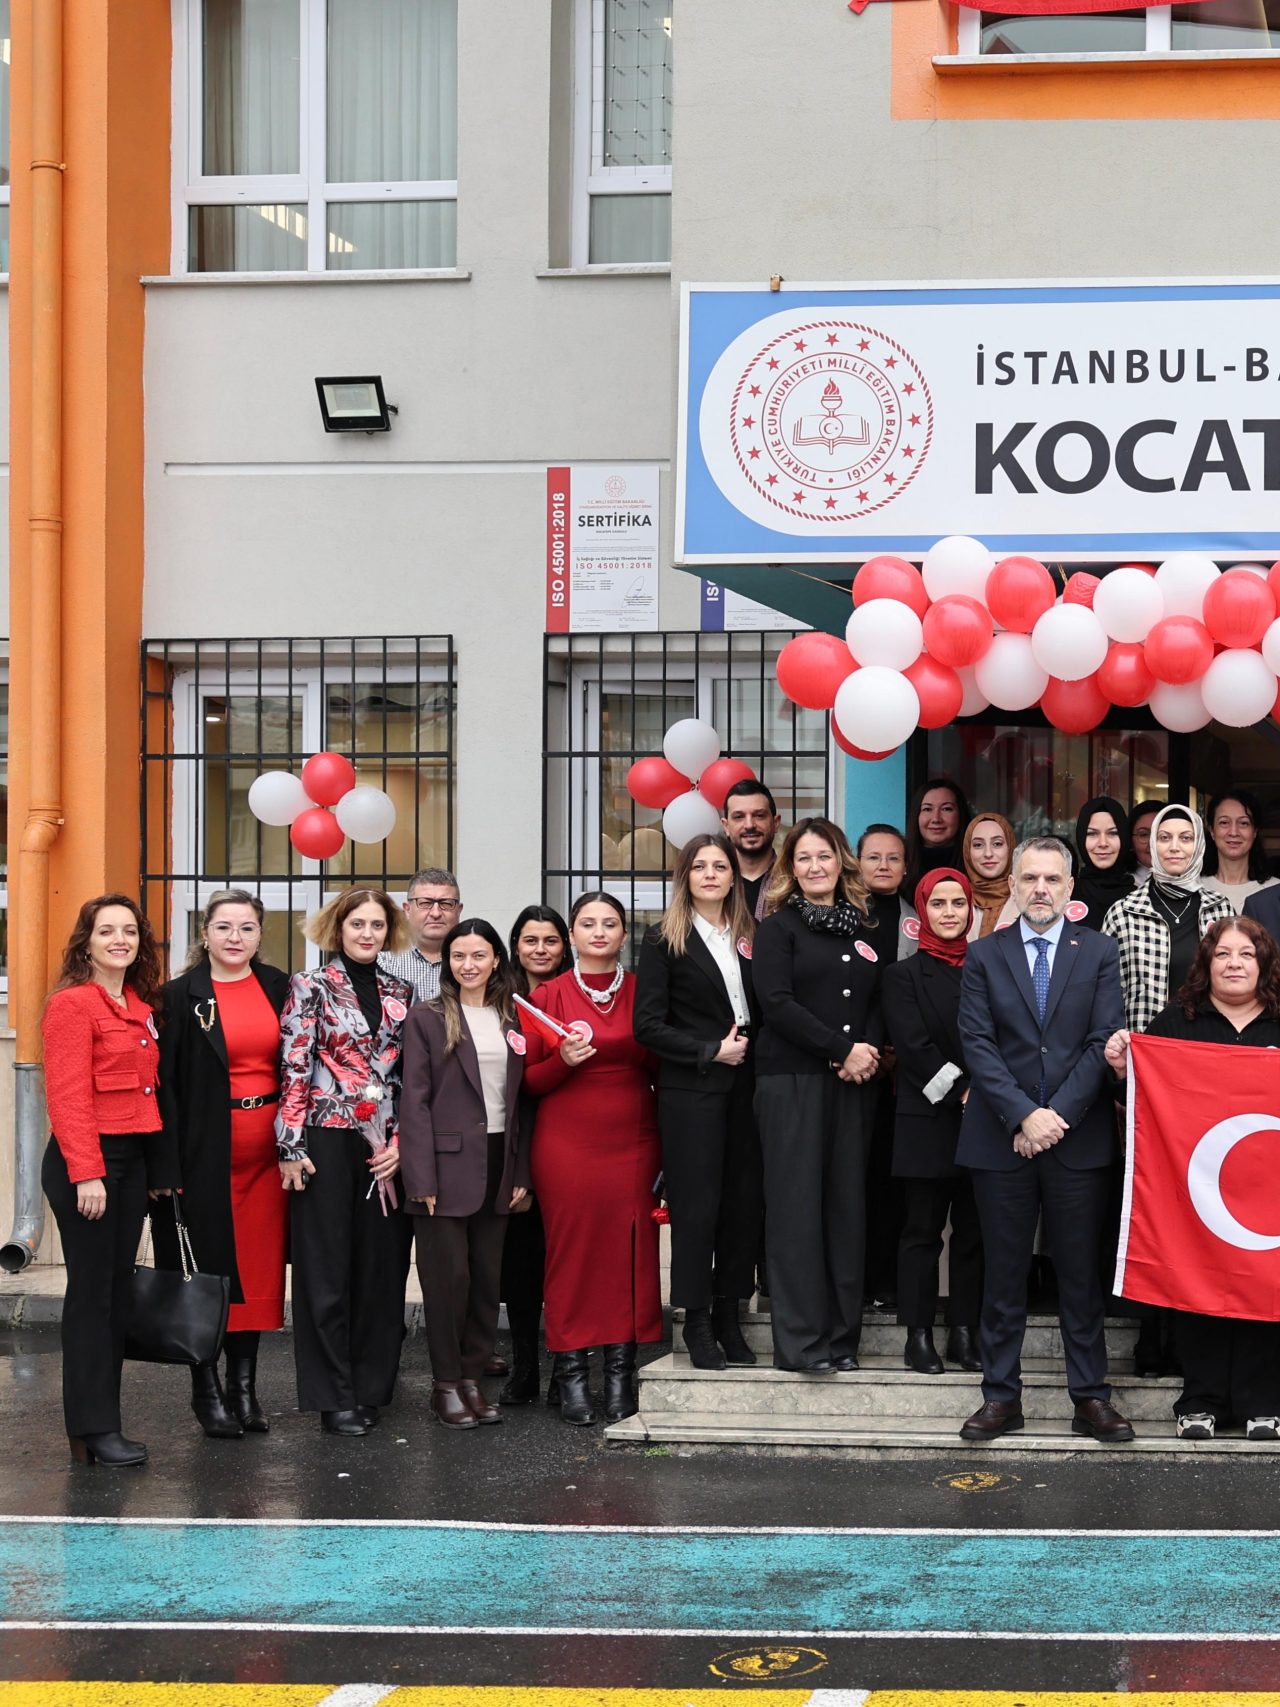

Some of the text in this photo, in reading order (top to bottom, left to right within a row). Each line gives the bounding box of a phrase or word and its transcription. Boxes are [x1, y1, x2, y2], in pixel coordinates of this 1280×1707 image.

[767, 356, 824, 436] CUMHURİYETİ
[866, 371, 896, 415] EĞİTİM
[771, 440, 816, 482] TÜRKİYE
[847, 418, 896, 482] BAKANLIĞI
[578, 511, 652, 527] SERTİFİKA
[552, 492, 565, 607] ISO 45001:2018
[706, 580, 719, 601] IS
